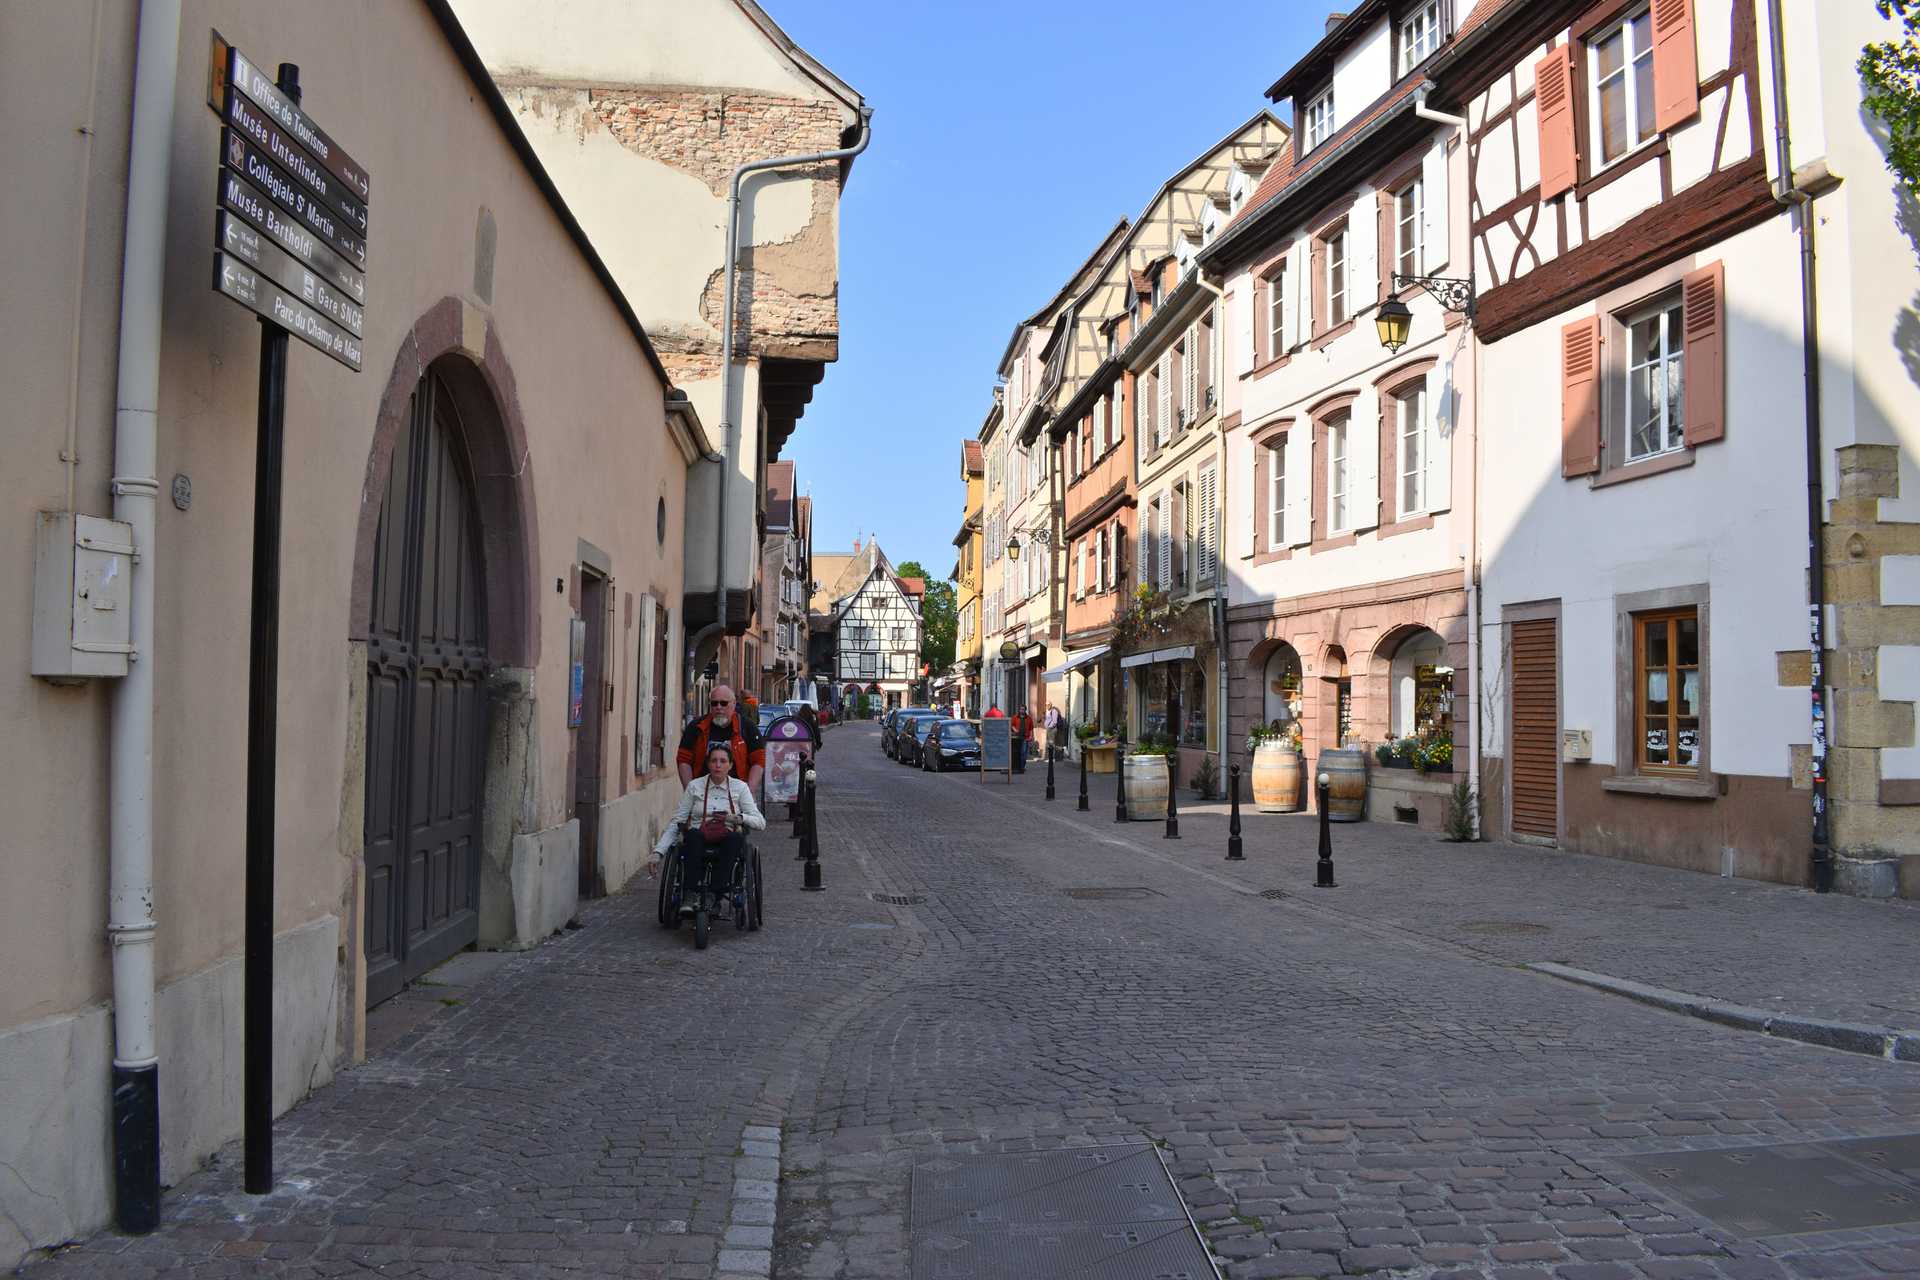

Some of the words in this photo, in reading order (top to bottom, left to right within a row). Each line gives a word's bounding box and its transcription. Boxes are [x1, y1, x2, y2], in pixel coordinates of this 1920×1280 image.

[232, 98, 268, 144] Musée
[271, 132, 327, 195] Unterlinden
[252, 76, 280, 114] Office
[281, 104, 293, 126] de
[294, 111, 329, 159] Tourisme
[227, 179, 264, 222] Musée
[266, 209, 313, 259] Bartholdi
[249, 154, 295, 206] Collégiale
[306, 202, 335, 239] Martin
[274, 295, 294, 323] Parc
[295, 311, 306, 331] du
[307, 316, 333, 350] Champ
[333, 333, 343, 353] de
[343, 339, 361, 364] Mars
[318, 287, 338, 314] Gare
[340, 302, 363, 330] SNCF
